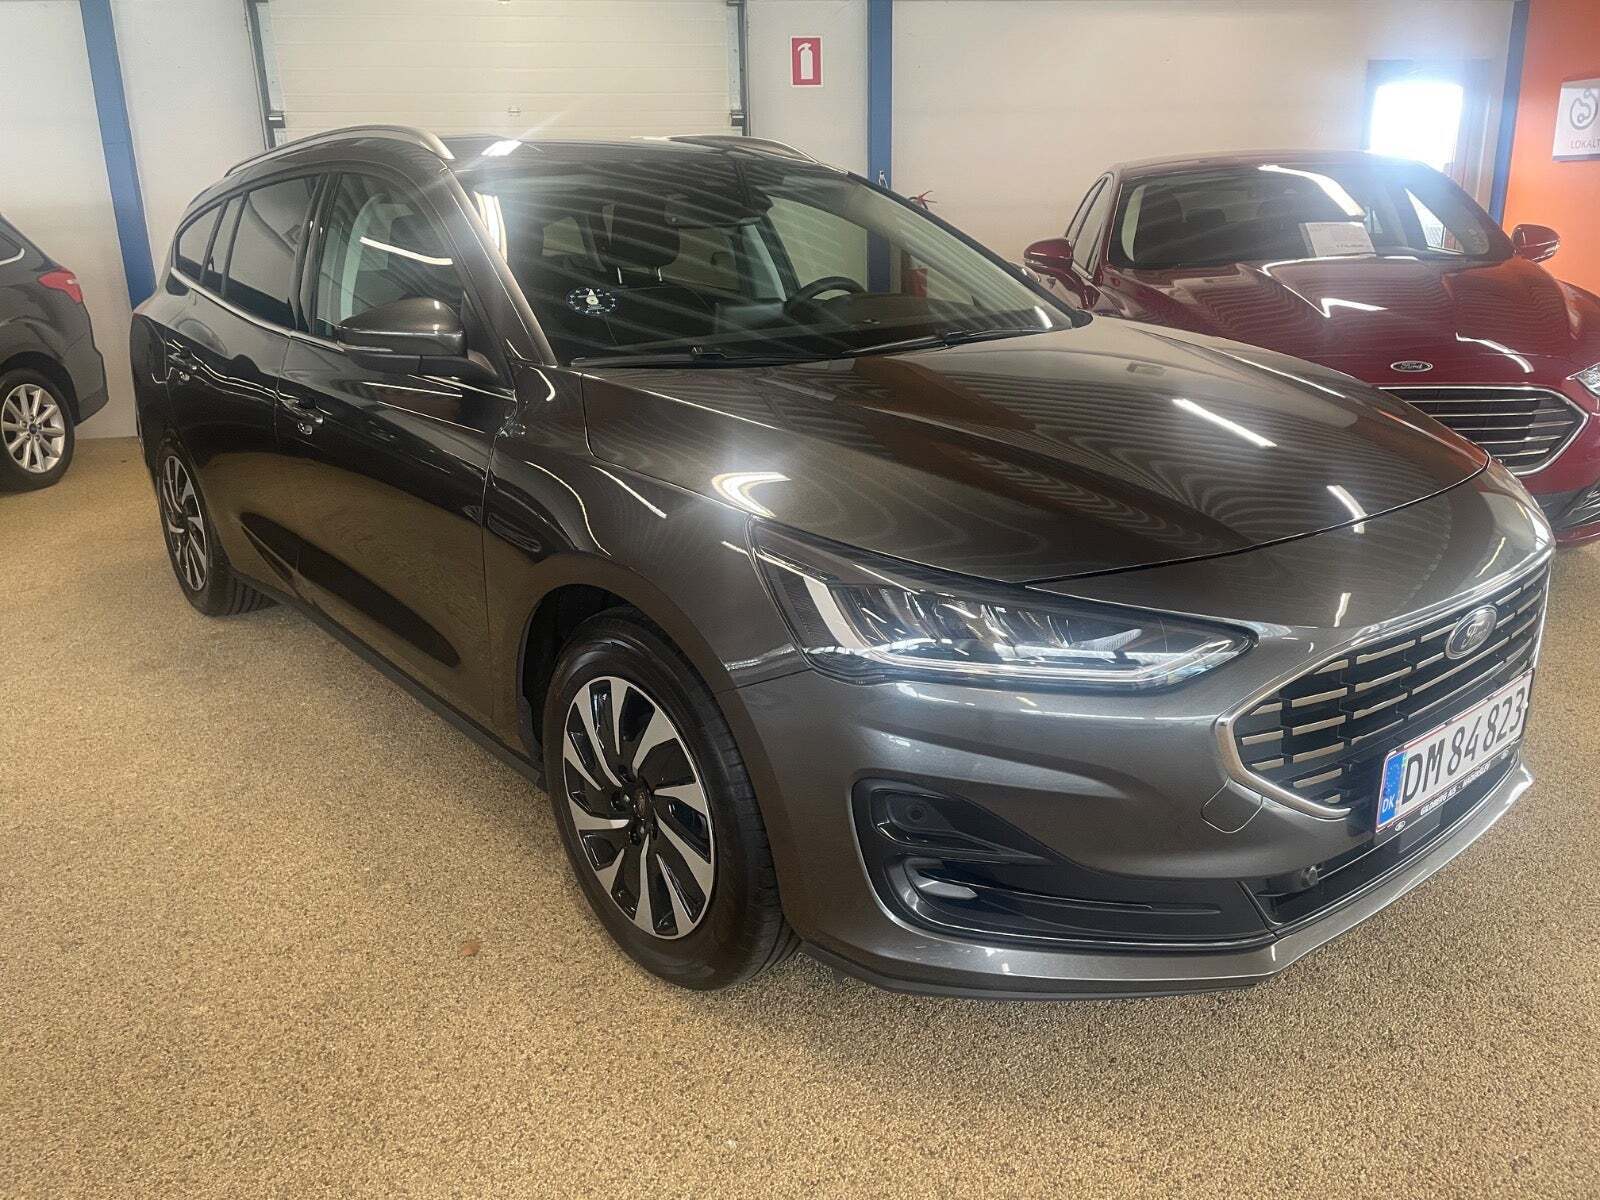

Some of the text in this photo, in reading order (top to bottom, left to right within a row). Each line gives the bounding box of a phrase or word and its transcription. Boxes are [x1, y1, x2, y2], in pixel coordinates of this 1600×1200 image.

[1399, 361, 1423, 370] Ford
[1401, 738, 1445, 805] DM
[1447, 714, 1482, 776] 84
[1483, 686, 1526, 750] 823
[1381, 793, 1396, 813] DK
